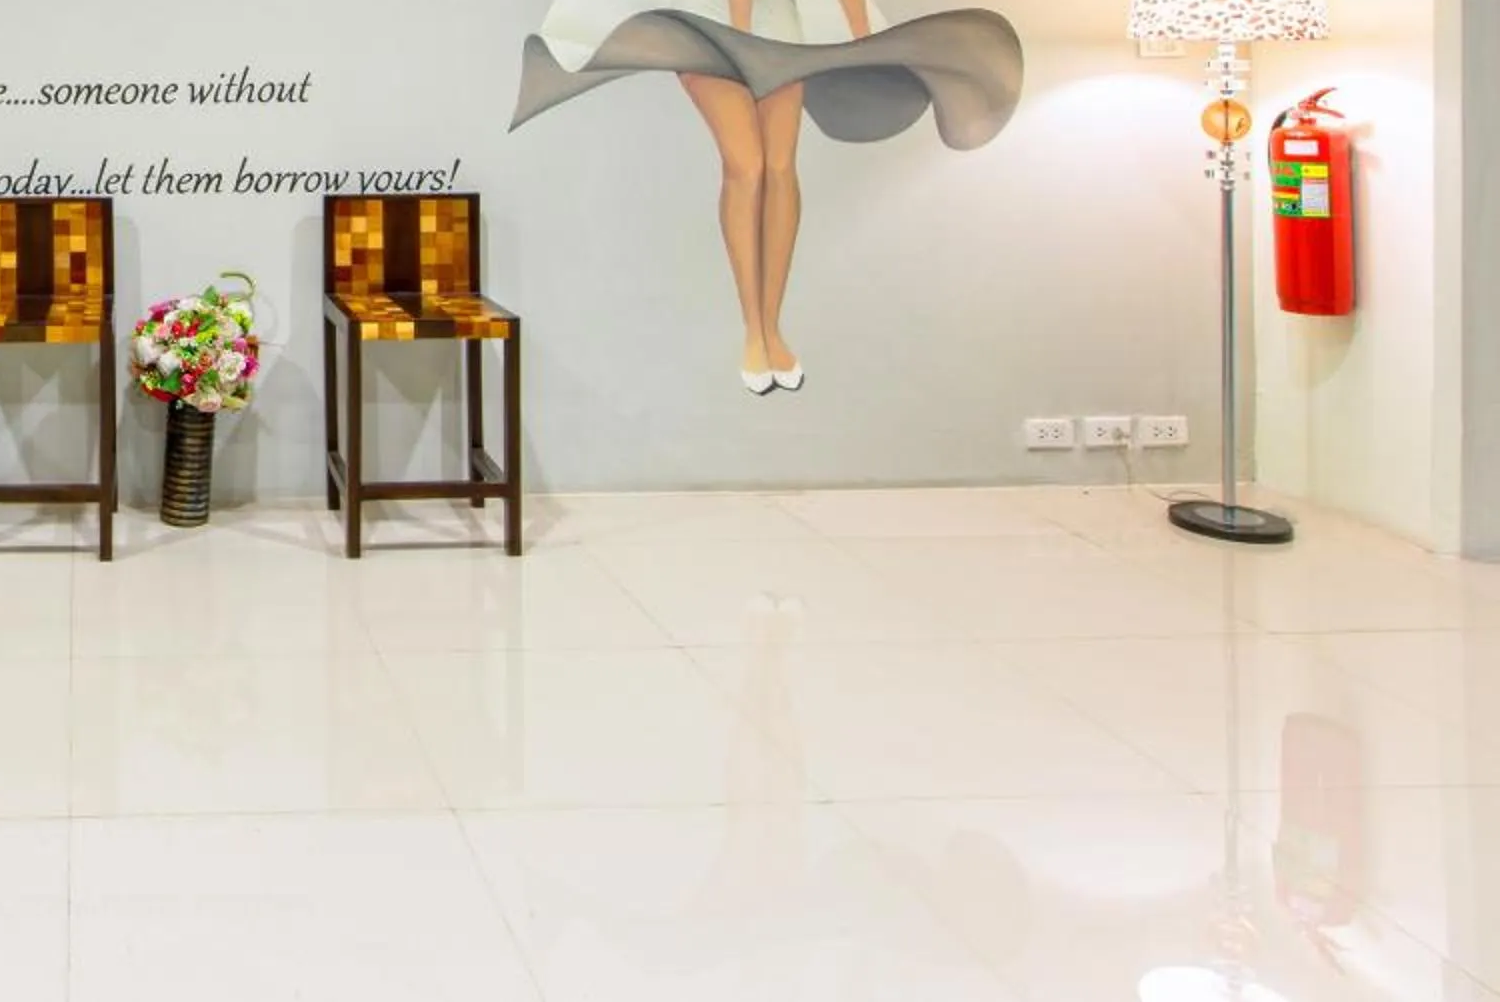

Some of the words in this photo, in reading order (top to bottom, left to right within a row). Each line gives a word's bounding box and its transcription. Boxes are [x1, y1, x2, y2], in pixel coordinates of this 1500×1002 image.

[187, 65, 313, 105] without
[141, 156, 224, 195] them
[232, 156, 349, 195] borrow
[357, 157, 462, 195] yours!
